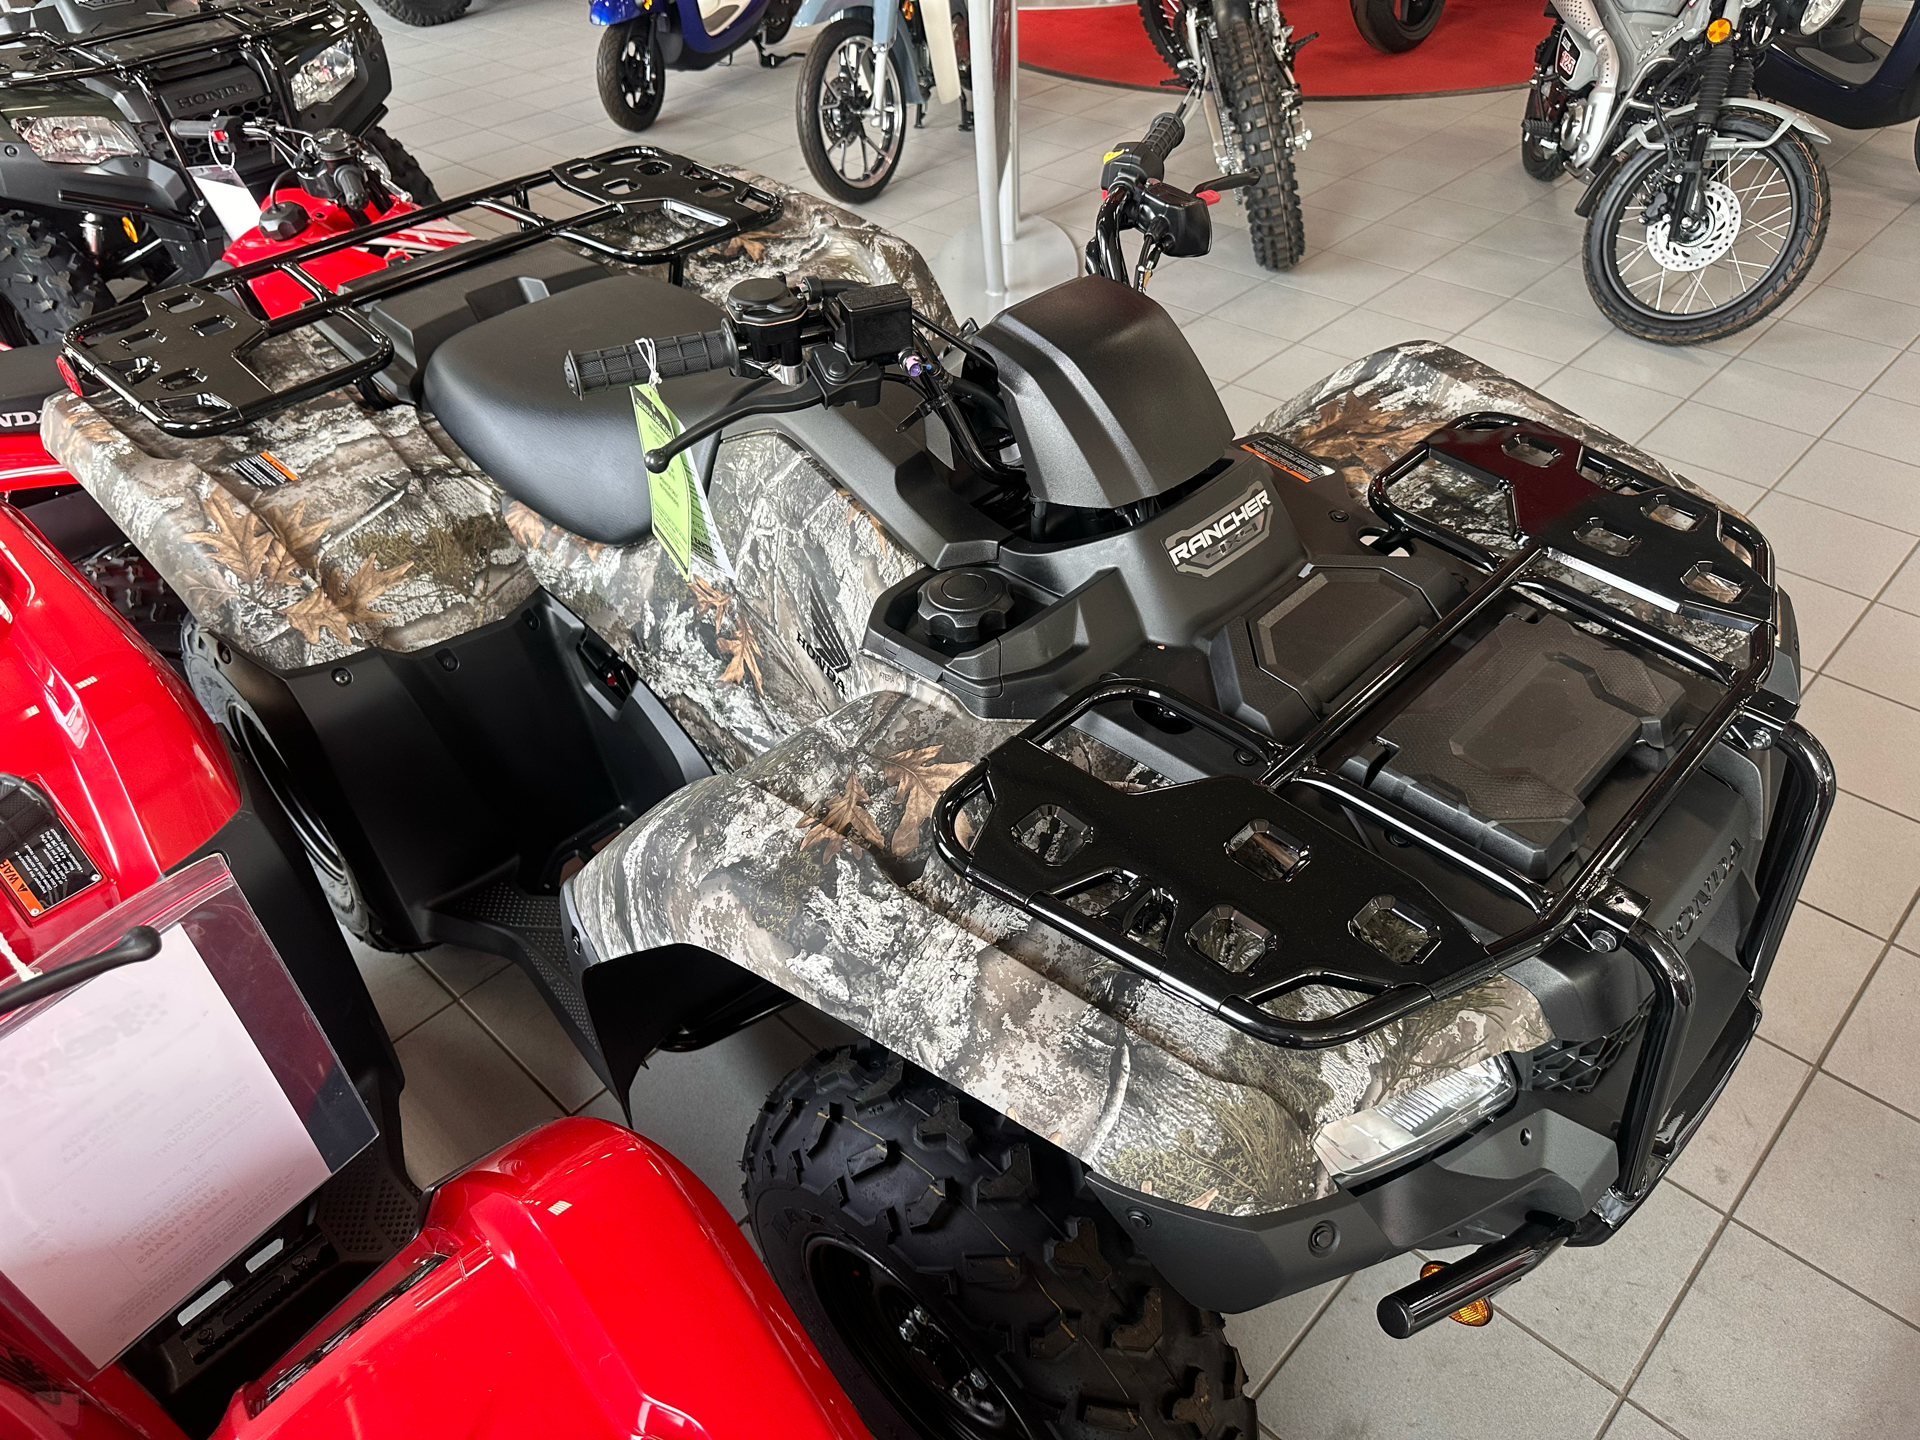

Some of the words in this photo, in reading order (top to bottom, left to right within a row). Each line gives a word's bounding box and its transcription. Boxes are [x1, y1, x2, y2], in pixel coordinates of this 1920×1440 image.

[175, 82, 255, 109] HONDA
[0, 410, 42, 427] ND
[1169, 489, 1271, 566] RANCHER
[796, 630, 846, 696] HONDA
[0, 862, 19, 884] WAR
